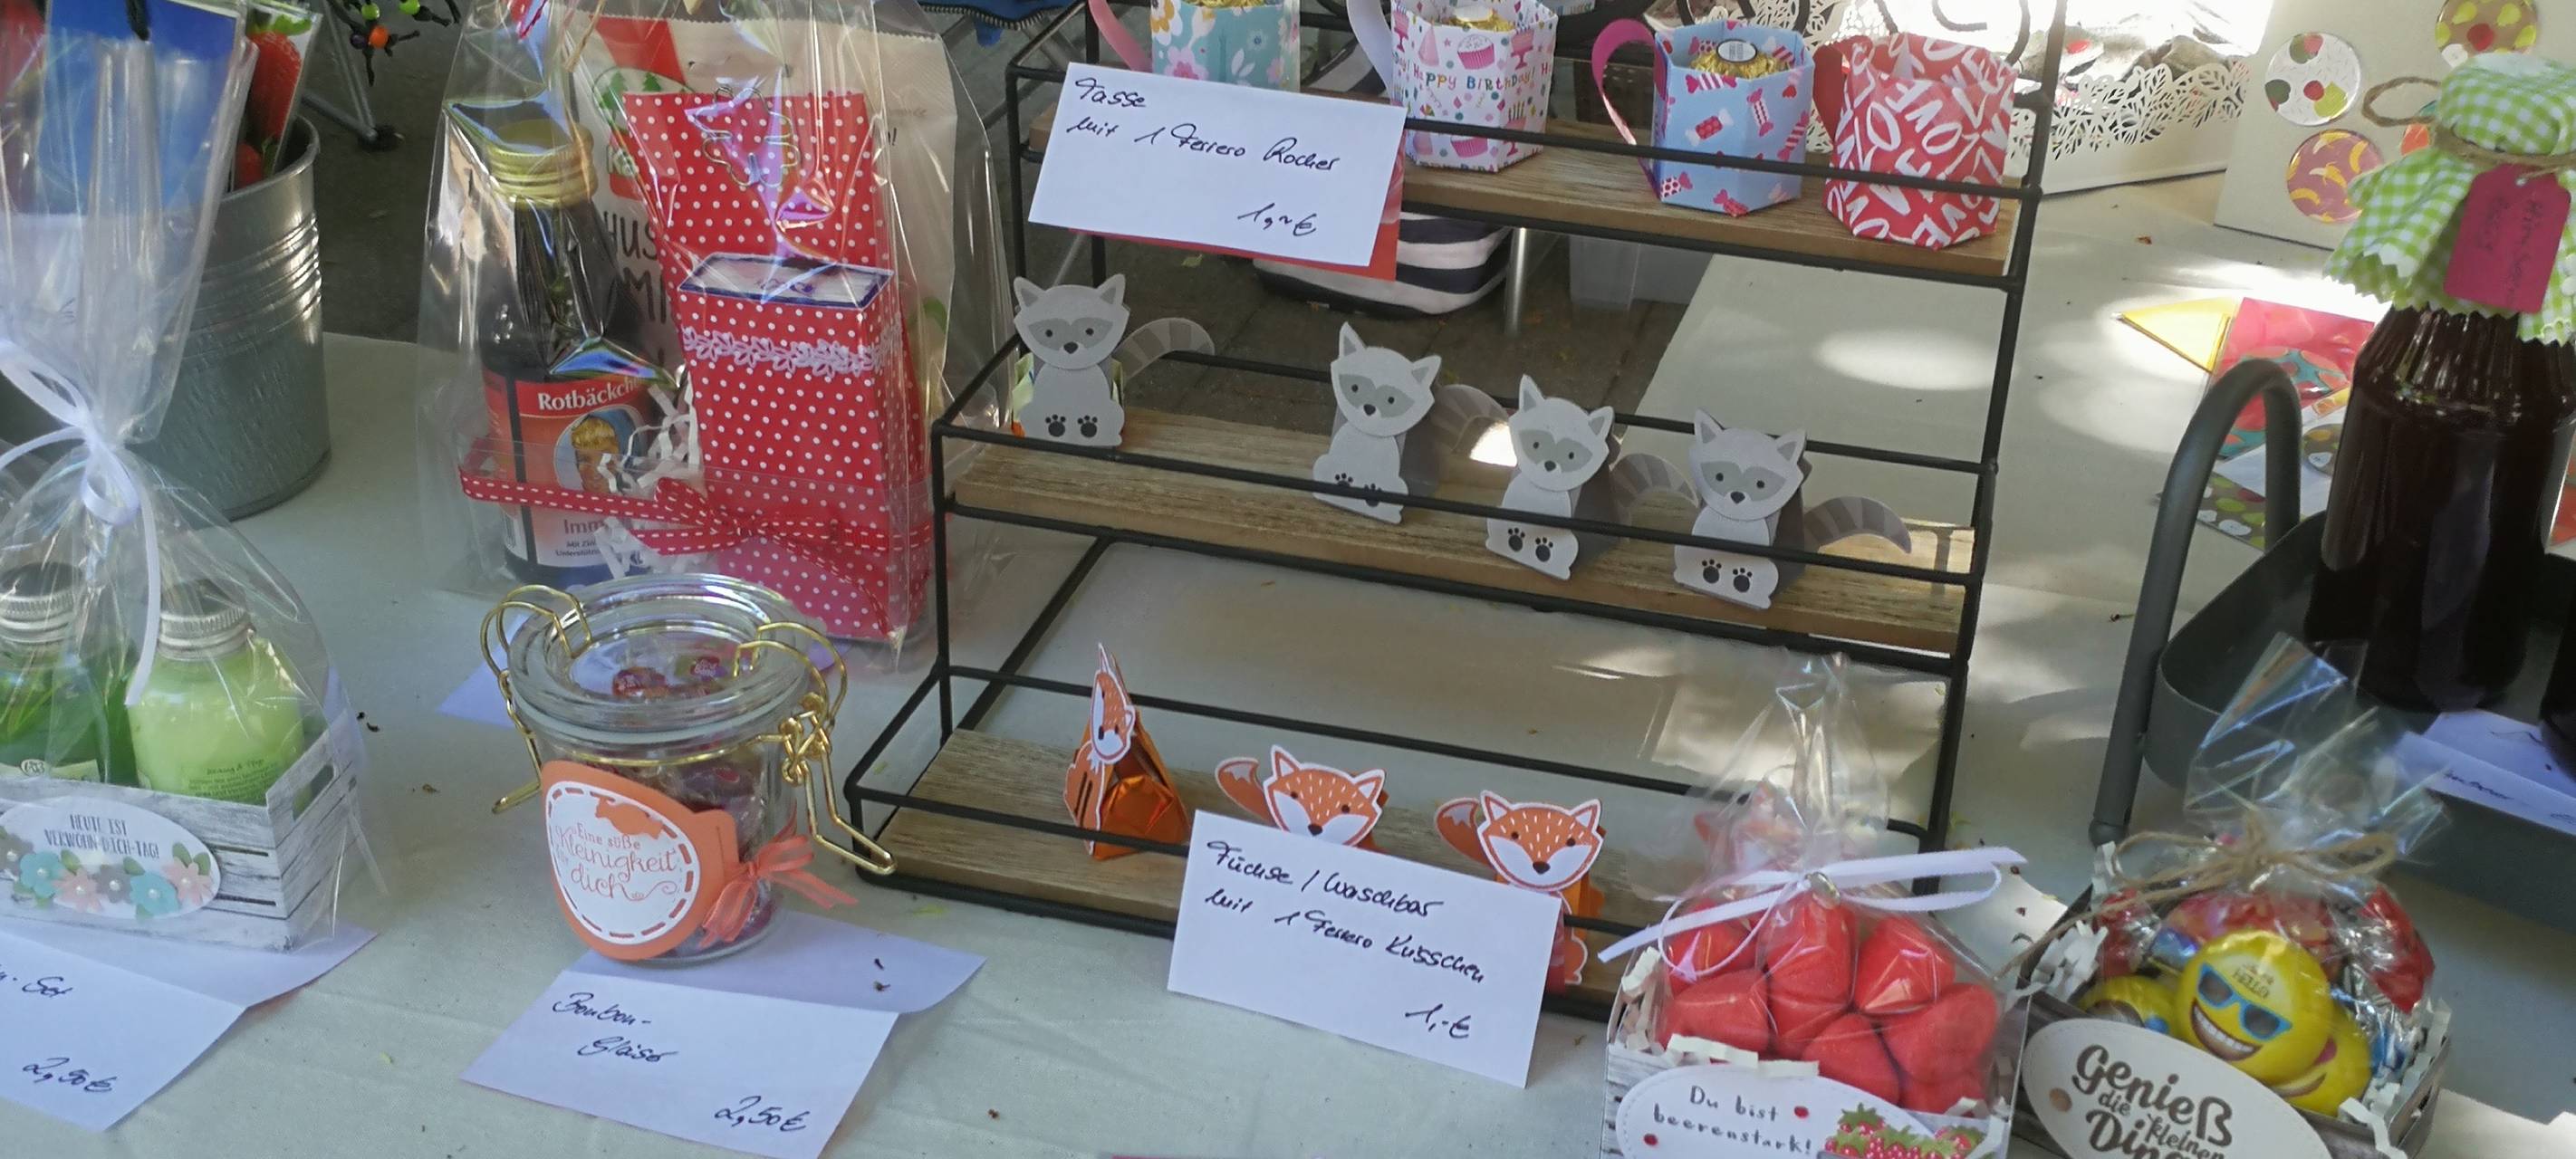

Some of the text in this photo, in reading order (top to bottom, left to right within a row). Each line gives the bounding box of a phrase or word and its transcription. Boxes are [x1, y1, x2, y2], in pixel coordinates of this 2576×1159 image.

[1075, 77, 1146, 107] Tasse
[1134, 127, 1167, 145] 1
[1170, 122, 1245, 158] Ferrero
[1263, 137, 1341, 172] Rocher
[577, 822, 641, 850] Eine süße
[1304, 909, 1373, 949] Ferrero
[714, 1095, 811, 1132] 2,50€
[1690, 1085, 1779, 1123] Du bist
[2071, 1044, 2233, 1147] Genieß
[1653, 1103, 1812, 1155] beerenstark!
[2098, 1088, 2225, 1159] die kleinen
